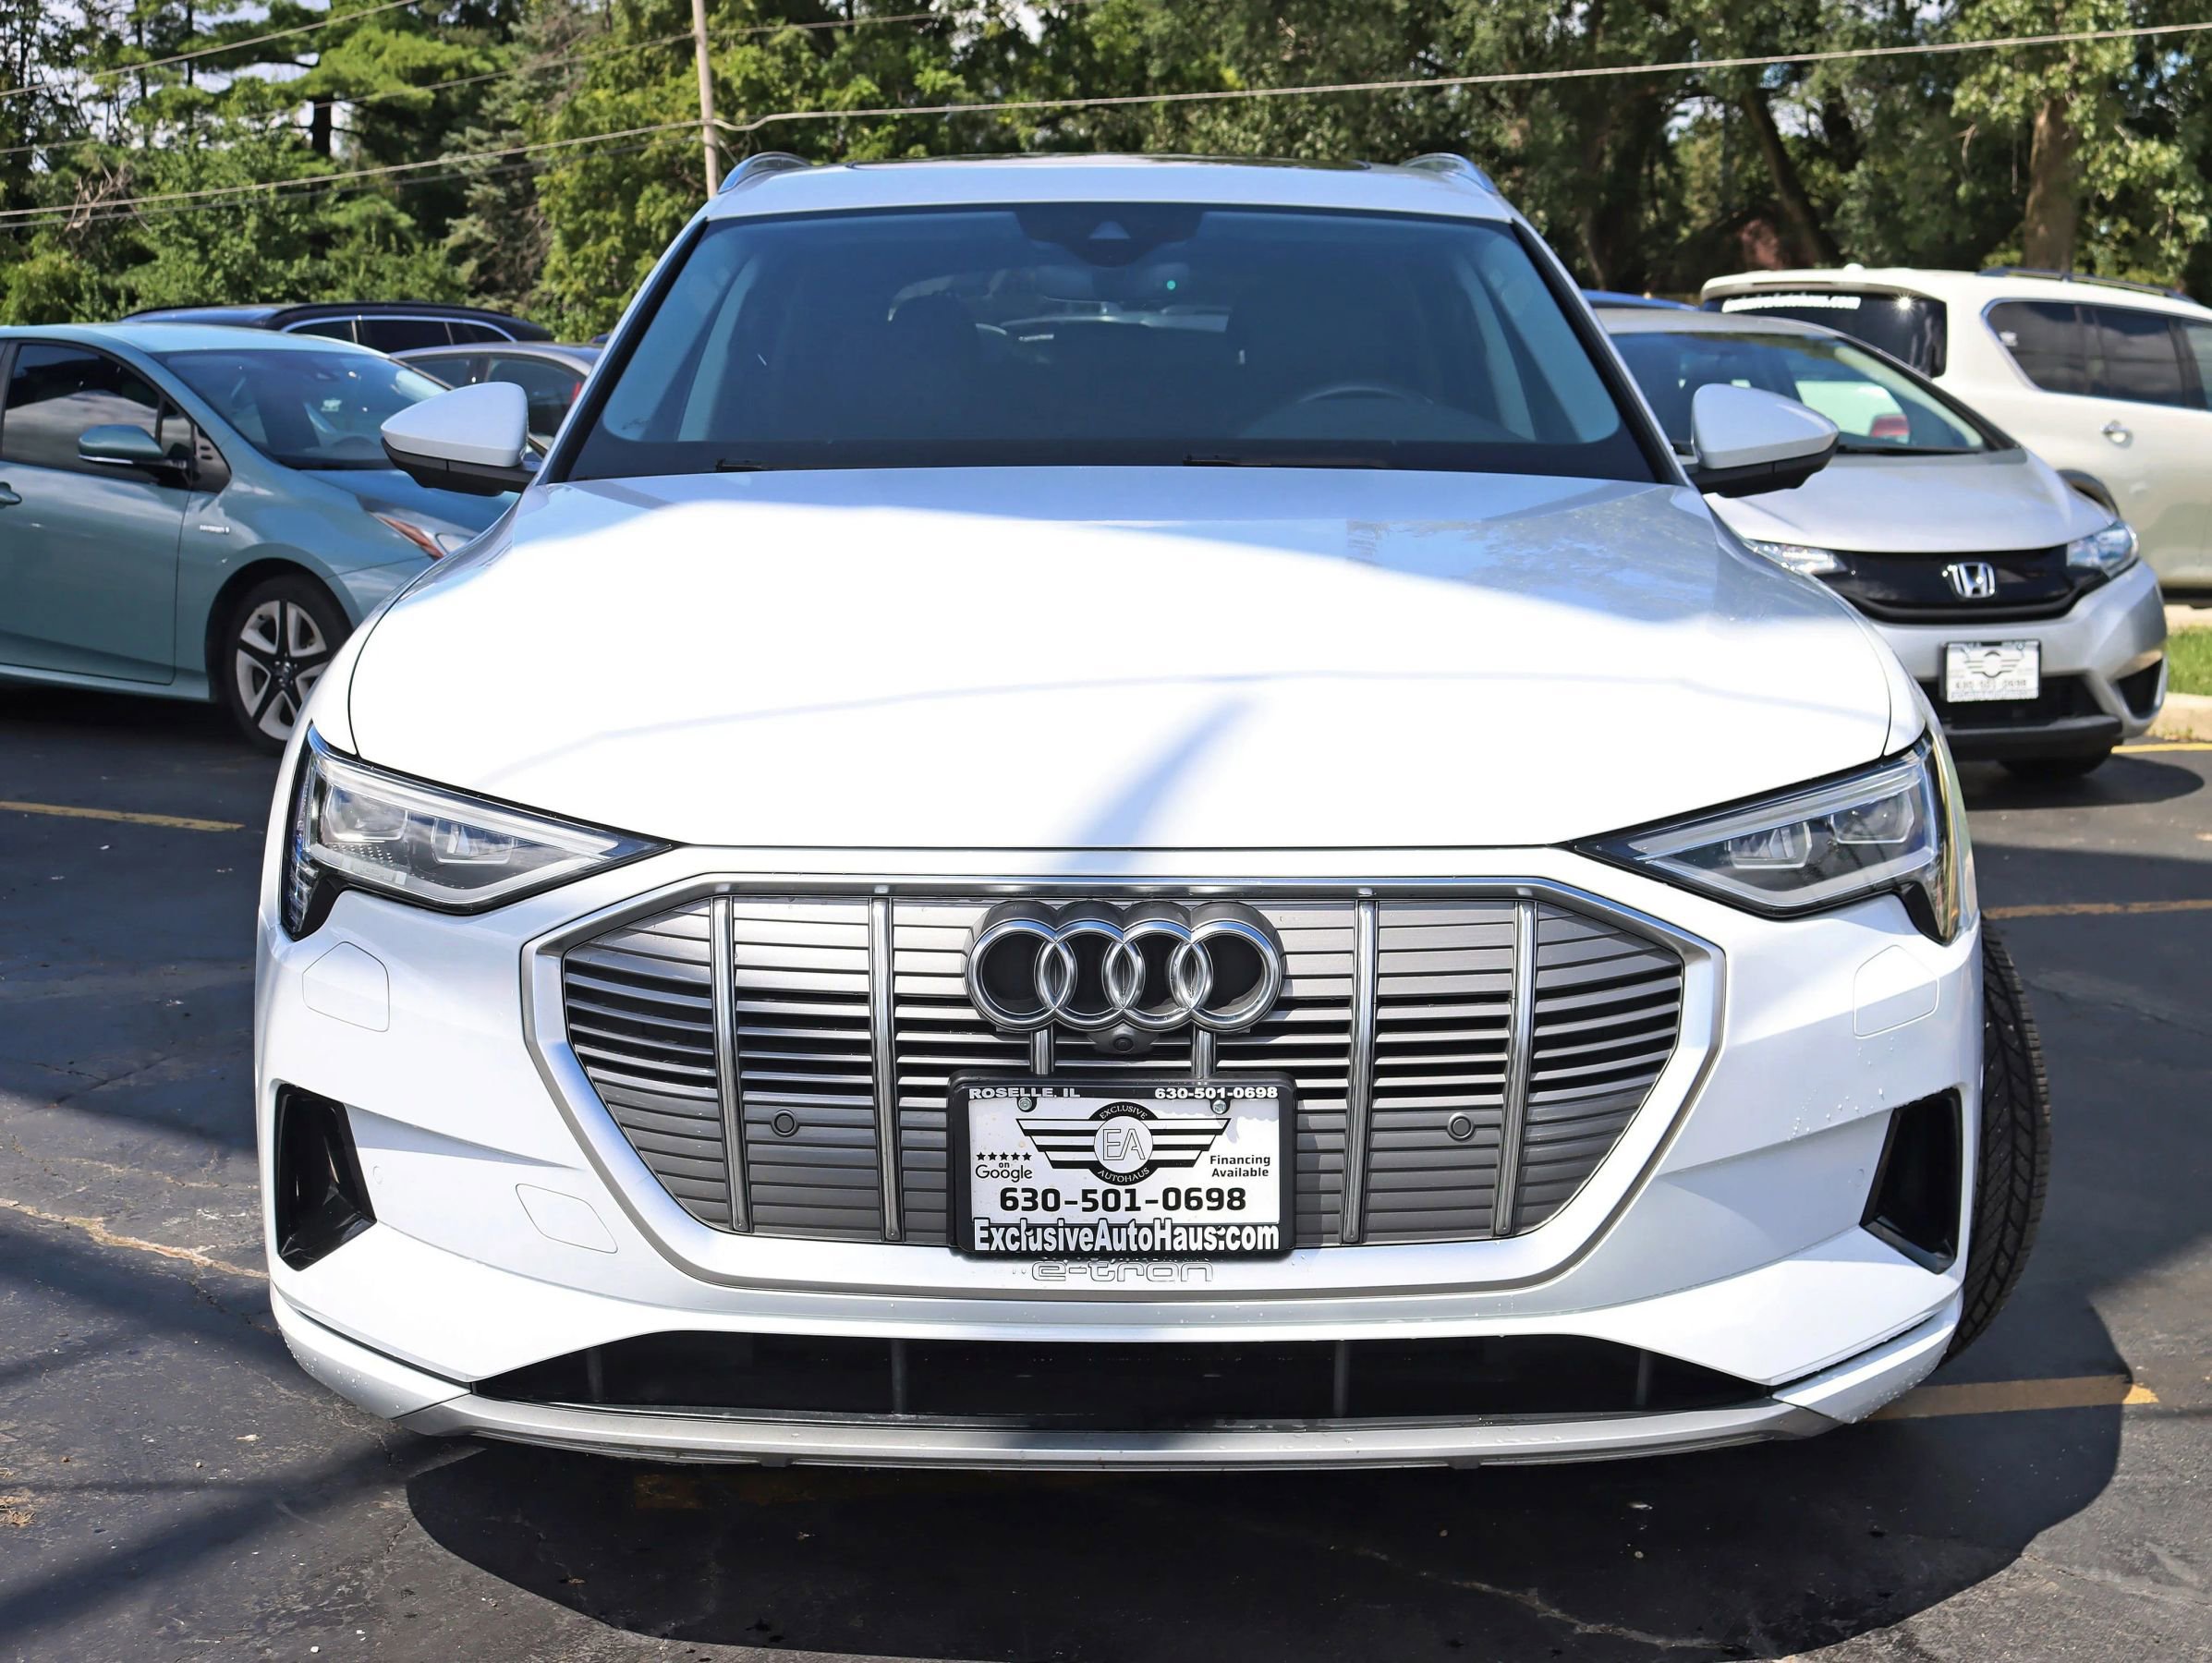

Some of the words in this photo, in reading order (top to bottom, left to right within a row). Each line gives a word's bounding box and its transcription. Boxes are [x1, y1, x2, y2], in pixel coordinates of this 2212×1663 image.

[1063, 1087, 1081, 1099] IL
[1154, 1086, 1279, 1099] 630-501-0698
[1099, 1104, 1149, 1120] EXCLUSIVE
[1102, 1128, 1147, 1161] EA
[1209, 1154, 1271, 1167] Financing
[975, 1164, 1034, 1184] Google
[1097, 1167, 1150, 1184] AUTOHAUS
[1211, 1167, 1270, 1178] Available
[999, 1187, 1247, 1213] 630-501-0698
[973, 1218, 1281, 1252] ExclusiveAutoHaus.com
[1031, 1258, 1214, 1282] e-tron
